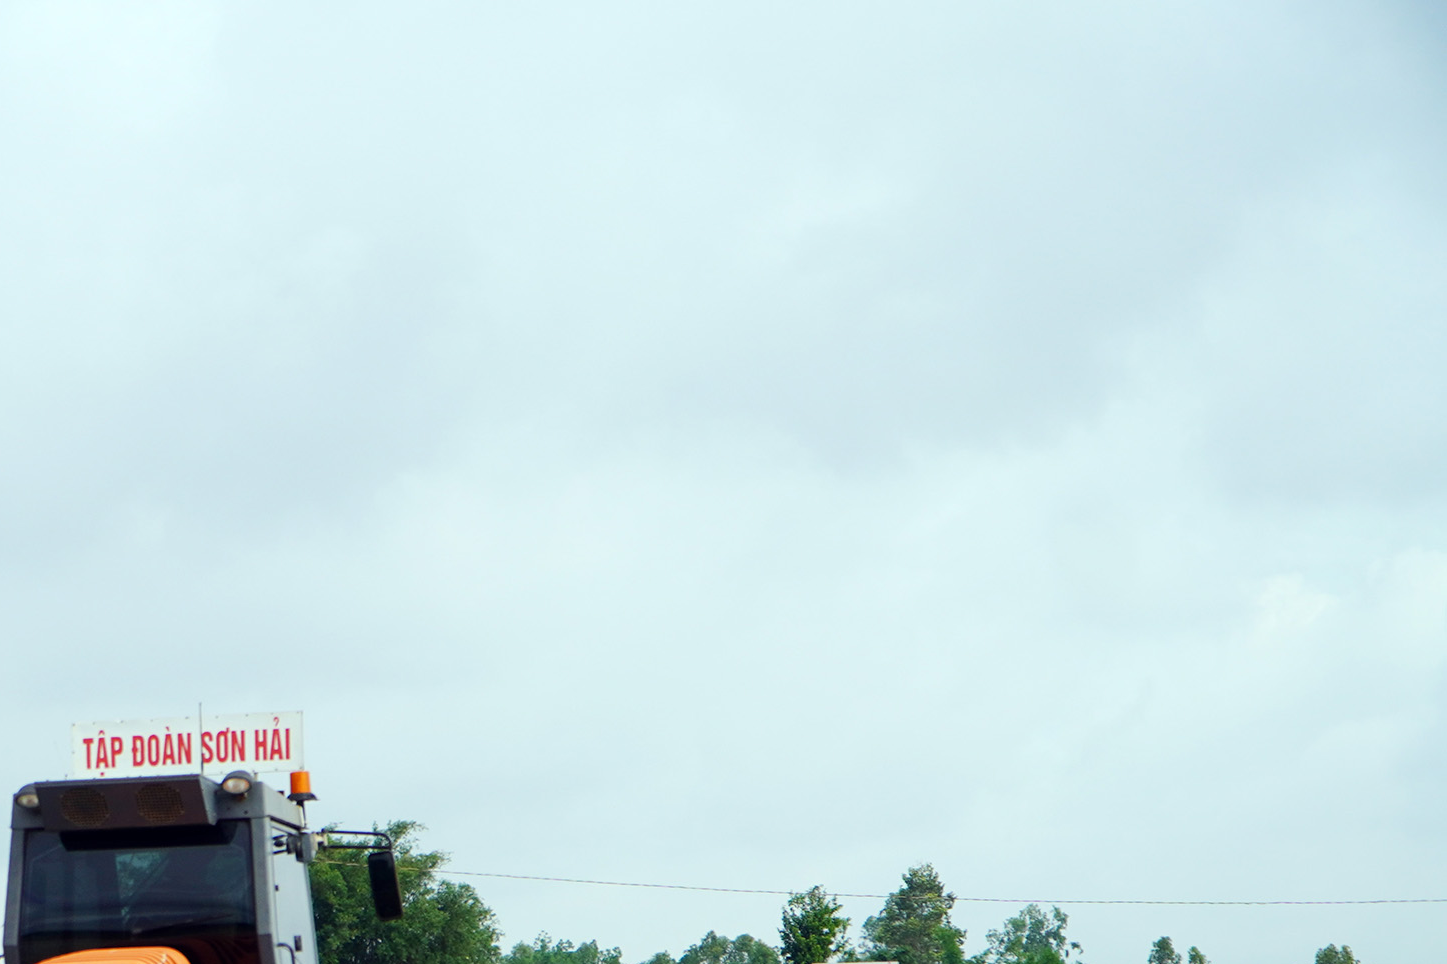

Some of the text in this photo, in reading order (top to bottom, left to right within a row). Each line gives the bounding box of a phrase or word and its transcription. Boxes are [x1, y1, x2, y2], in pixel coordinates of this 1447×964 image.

[82, 716, 291, 777] TẬP ĐOÀN SƠN HẢI
